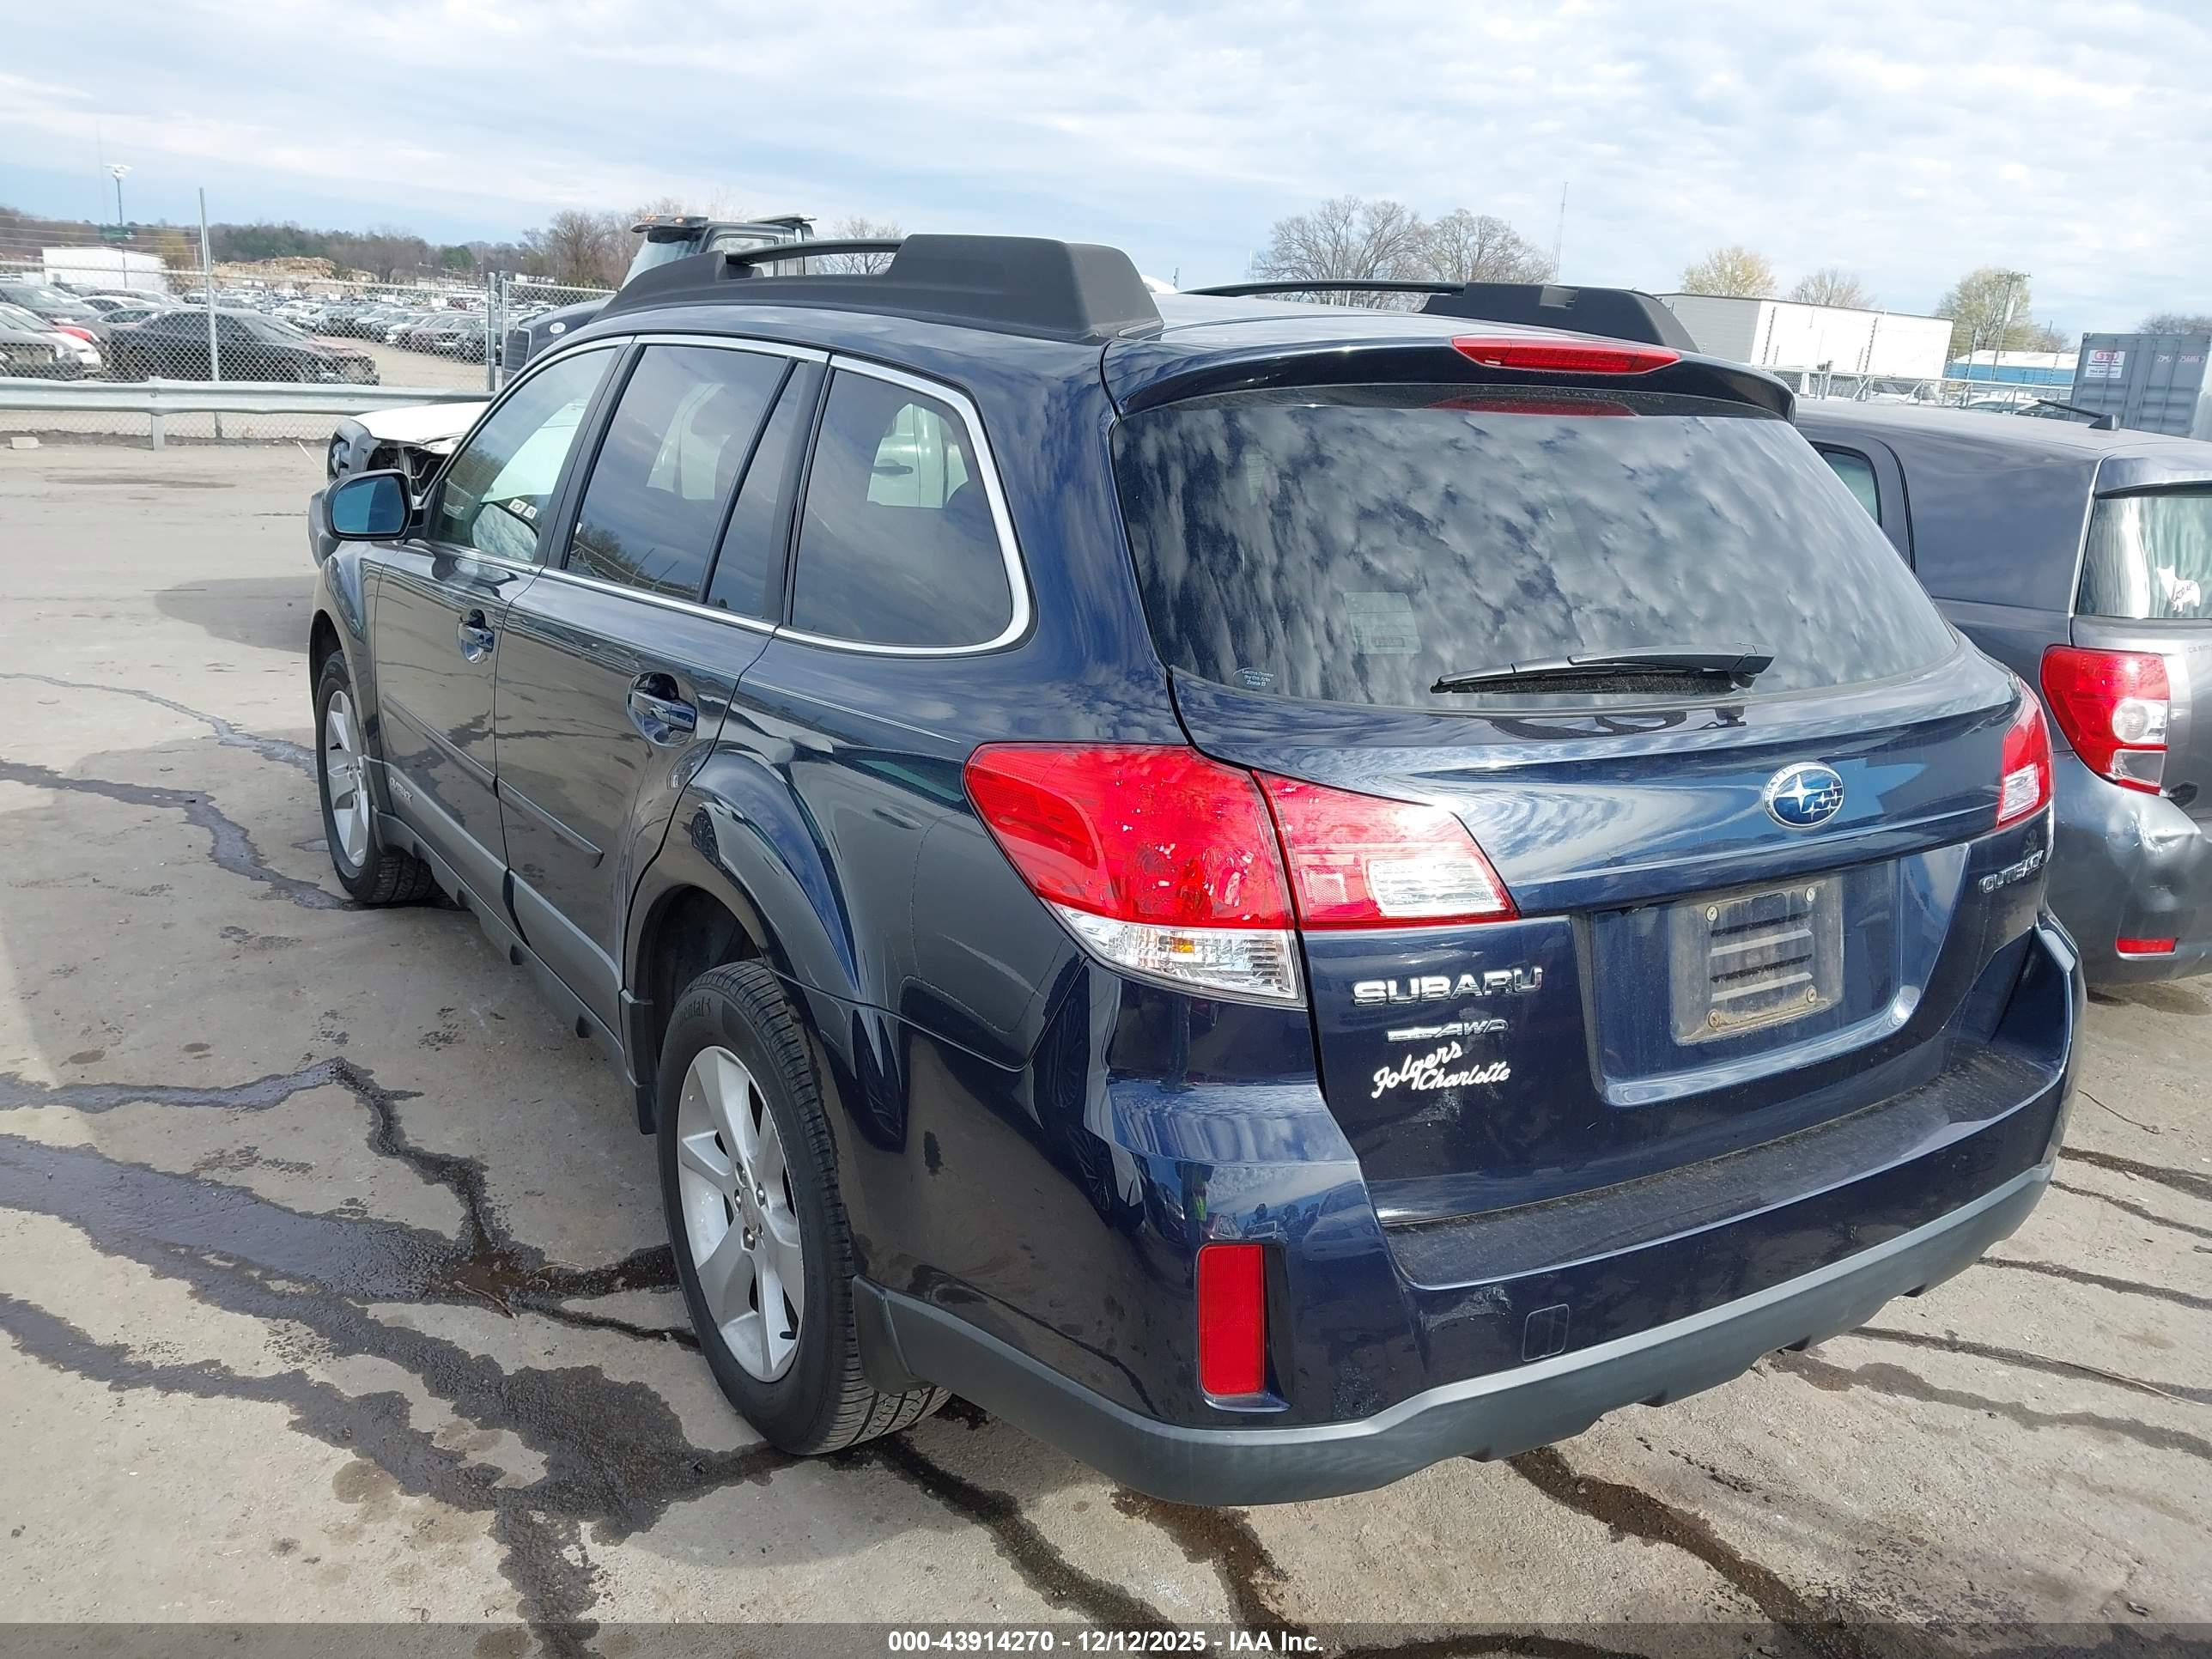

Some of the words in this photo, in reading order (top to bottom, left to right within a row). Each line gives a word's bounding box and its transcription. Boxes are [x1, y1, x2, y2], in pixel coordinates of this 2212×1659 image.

[1353, 967, 1543, 1007] SUBARU
[1436, 1018, 1510, 1038] AWD
[1417, 1060, 1511, 1091] Charlotte
